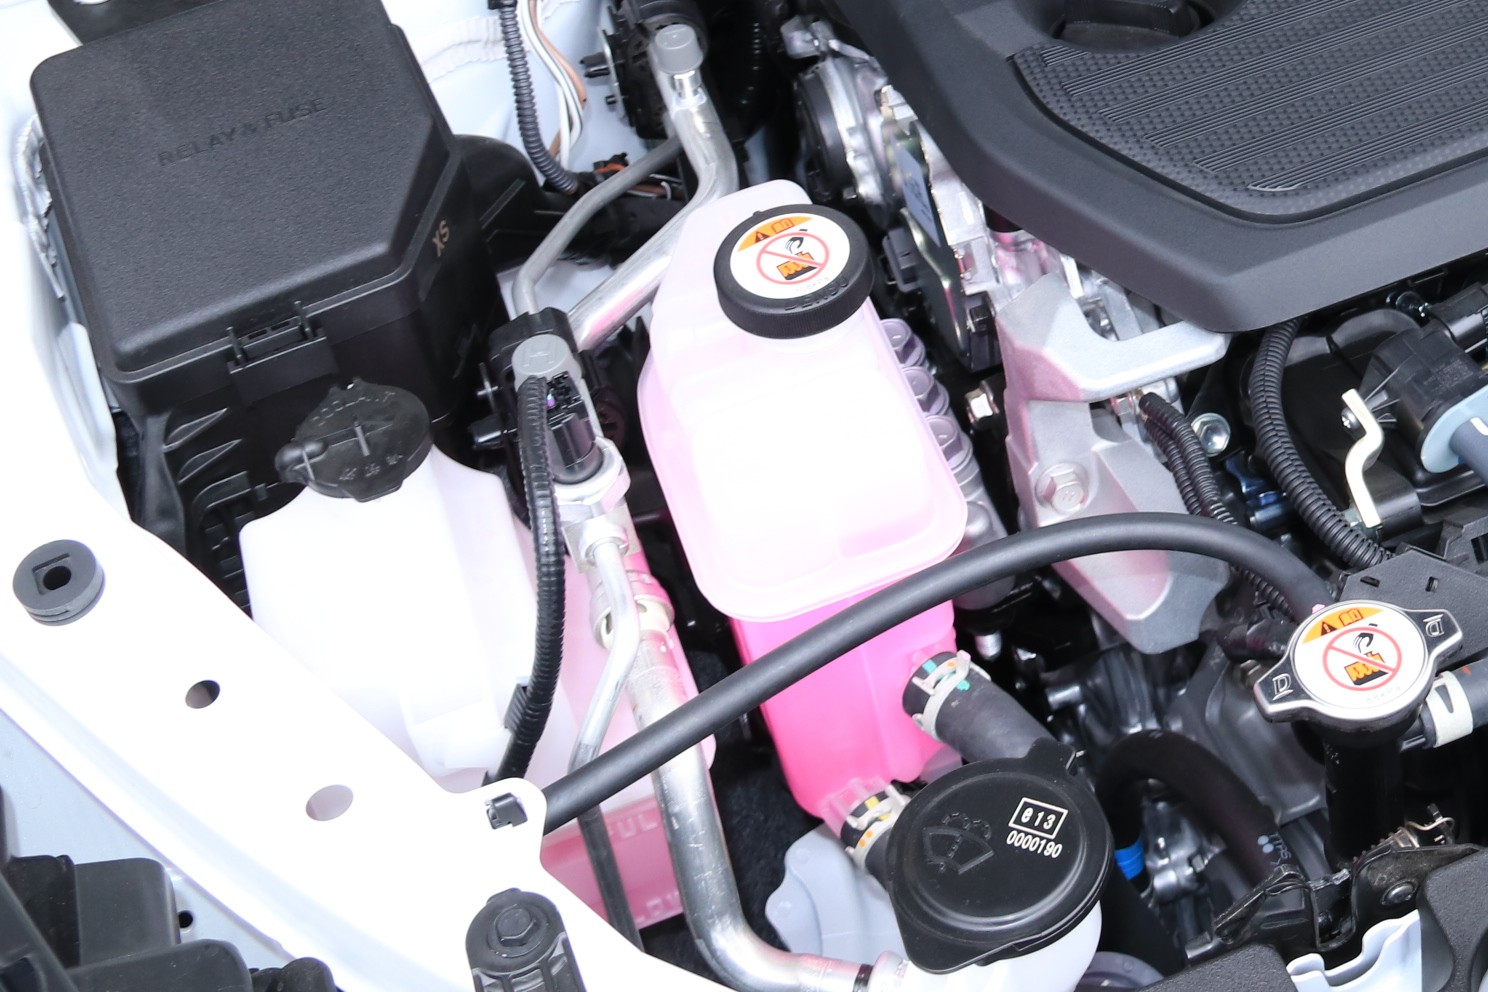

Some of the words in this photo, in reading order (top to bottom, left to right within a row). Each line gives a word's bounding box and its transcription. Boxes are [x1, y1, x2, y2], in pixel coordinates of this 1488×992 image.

[157, 126, 236, 168] RELAY
[265, 96, 329, 130] FUSE
[432, 219, 450, 257] XS
[1006, 830, 1063, 859] 0000190
